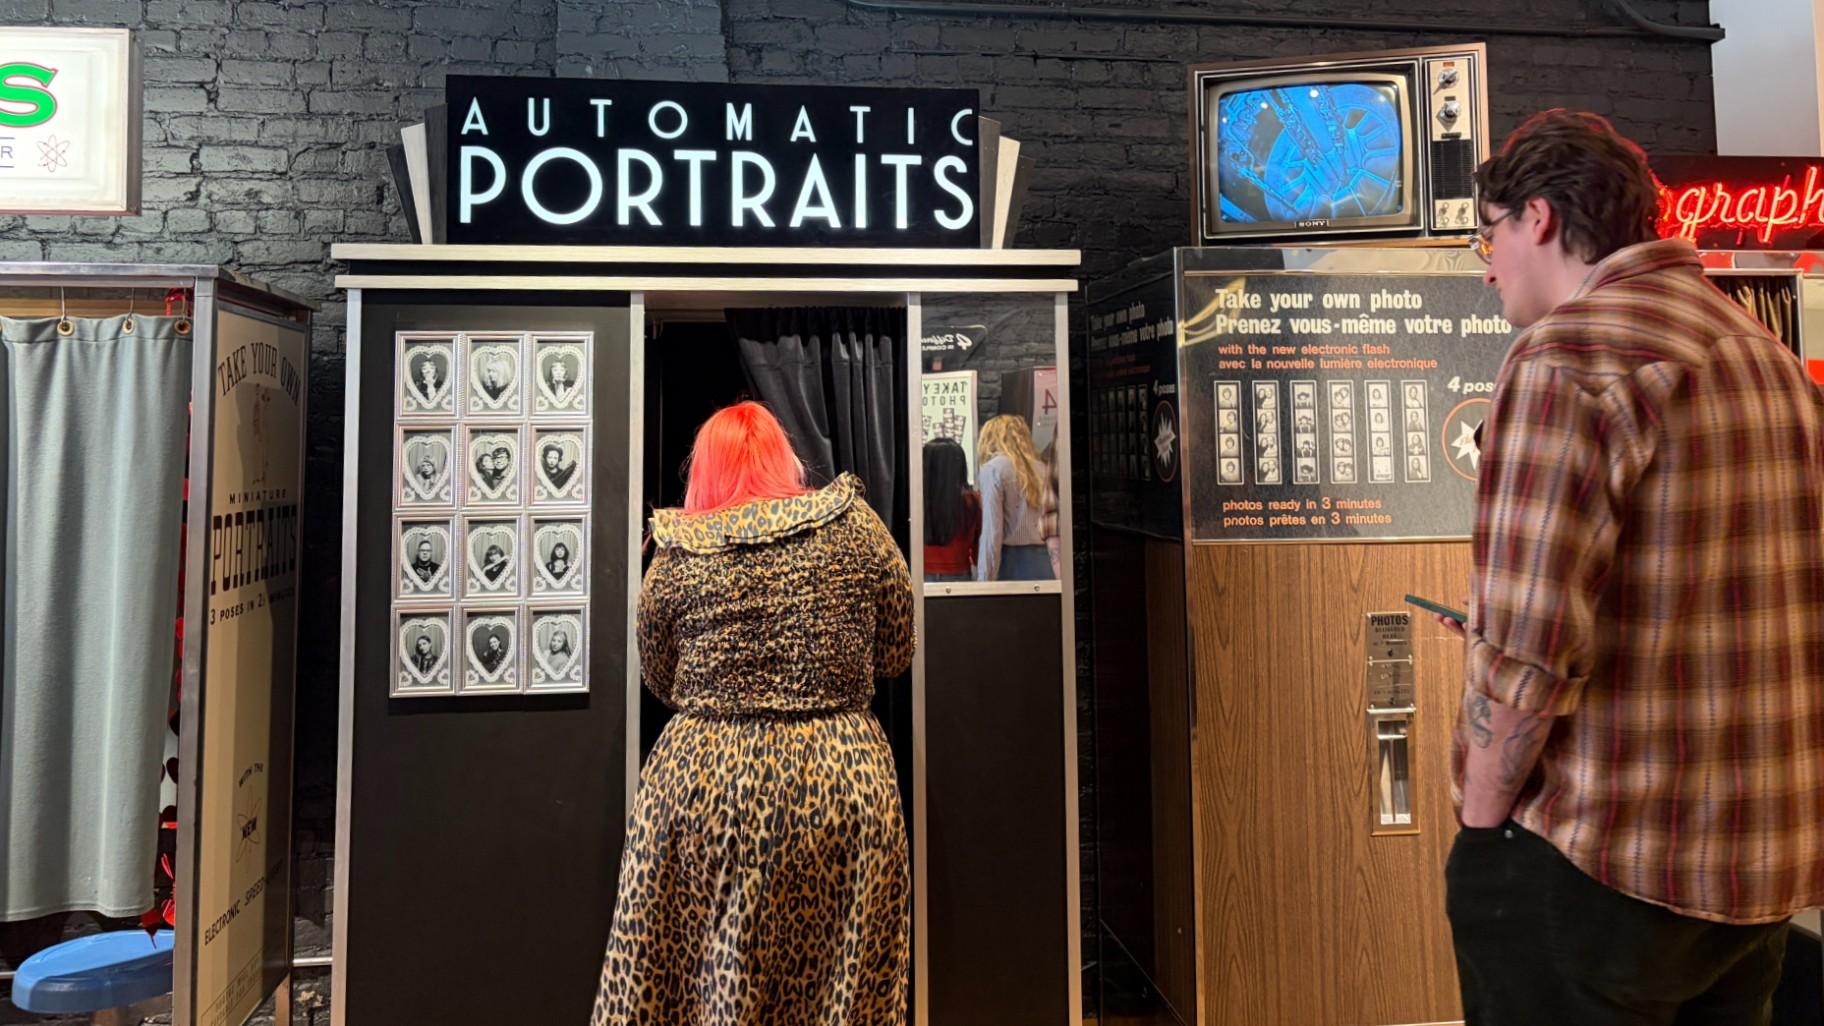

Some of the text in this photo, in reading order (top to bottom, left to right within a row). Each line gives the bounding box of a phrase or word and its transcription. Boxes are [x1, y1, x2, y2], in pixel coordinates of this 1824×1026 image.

[460, 97, 974, 146] AUTOMATIC
[459, 145, 974, 231] PORTRAITS
[1215, 288, 1423, 313] Take your own photo
[1216, 314, 1281, 334] Prenez
[1404, 314, 1453, 334] votre
[1460, 314, 1512, 337] photo
[1218, 344, 1391, 355] with the new electronic flash
[1219, 360, 1246, 369] avec
[1251, 358, 1262, 369] la
[1266, 358, 1315, 369] nouvelle
[218, 342, 301, 407] TAKE YOUR OWN
[1447, 376, 1496, 395] 4 pos
[229, 489, 287, 504] MINIATURE
[1222, 496, 1382, 512] photos ready in 3 minutes
[1311, 515, 1326, 525] en
[1331, 512, 1341, 525] 3
[1345, 513, 1392, 525] minutes
[210, 609, 216, 625] 3
[220, 603, 243, 622] POSES
[1371, 615, 1409, 626] PHOTOS
[204, 899, 241, 945] ELECTRONIC
